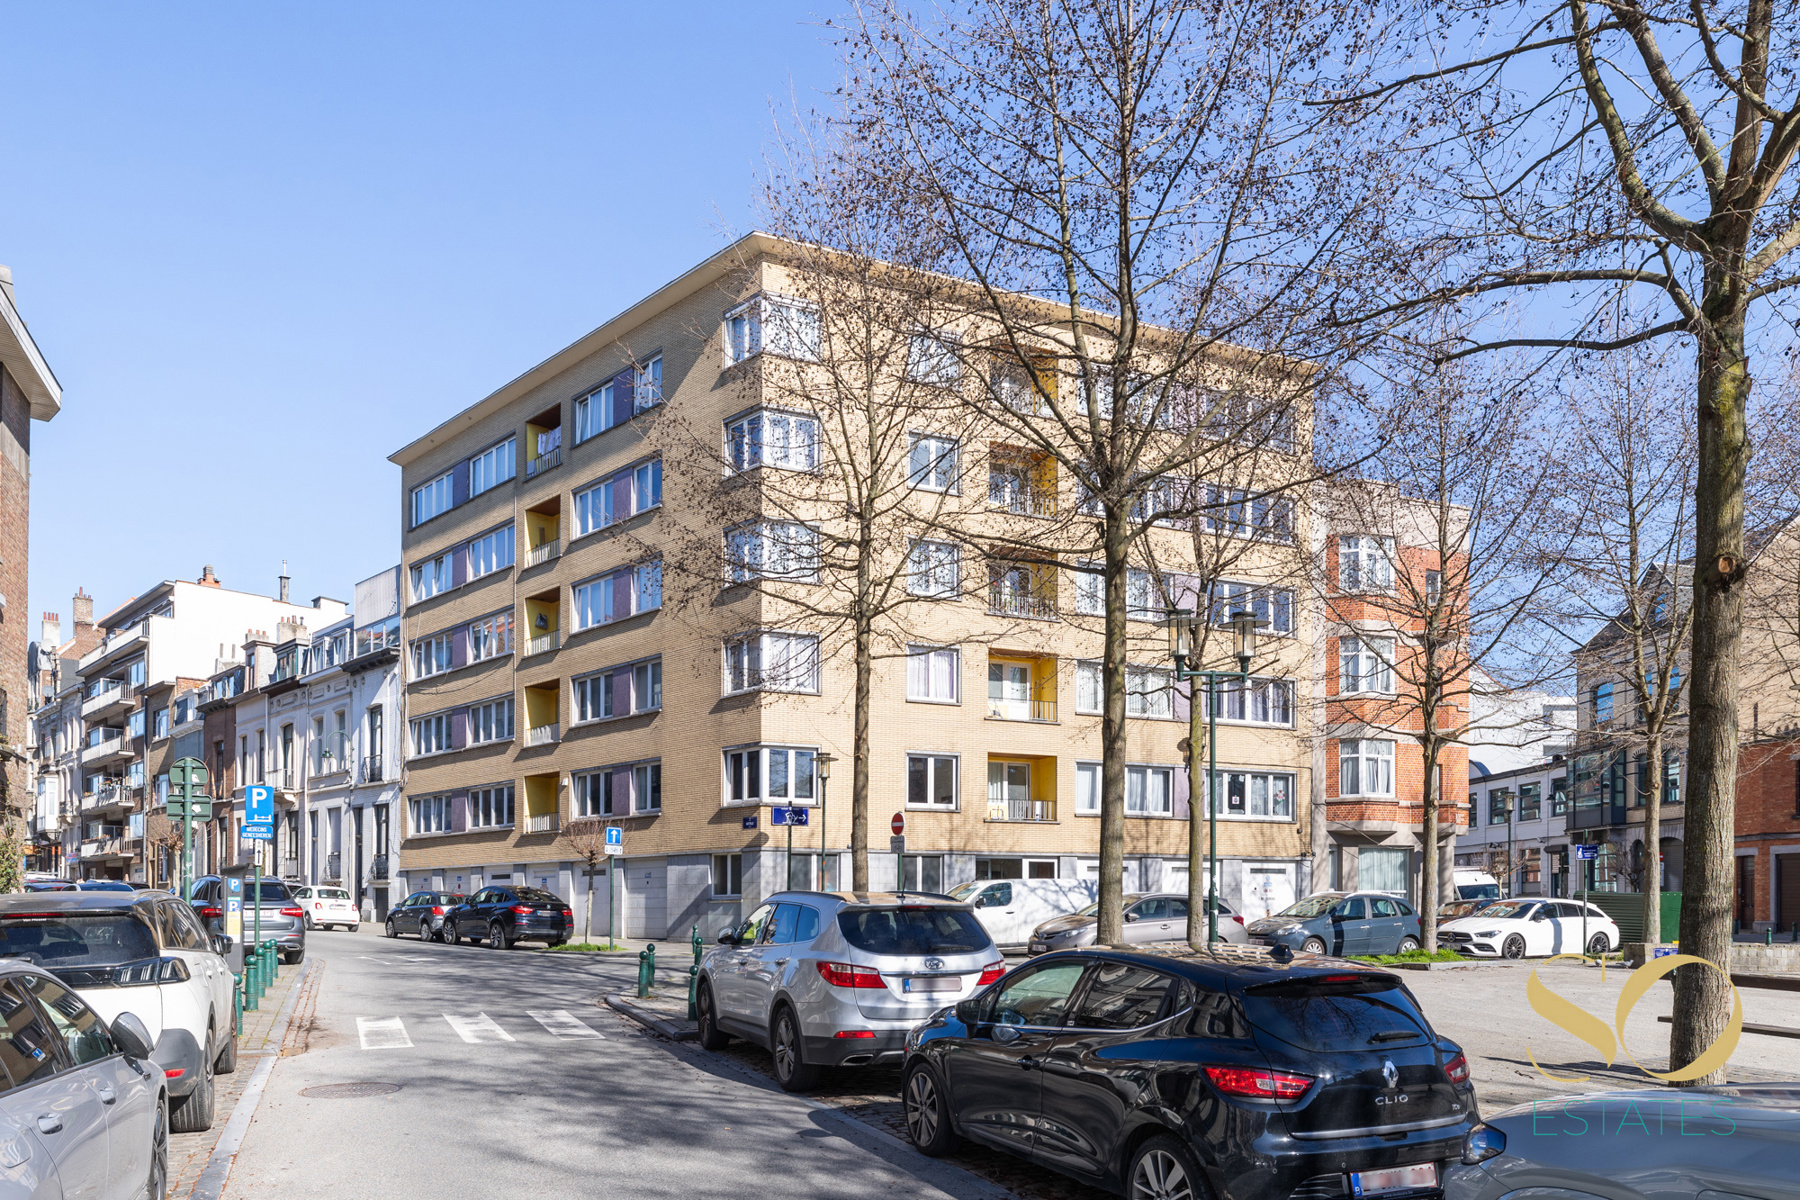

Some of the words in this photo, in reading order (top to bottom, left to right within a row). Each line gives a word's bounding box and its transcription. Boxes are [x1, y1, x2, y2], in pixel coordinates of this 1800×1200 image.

[252, 788, 267, 808] P
[231, 879, 239, 890] P
[1375, 1094, 1408, 1105] CLIO
